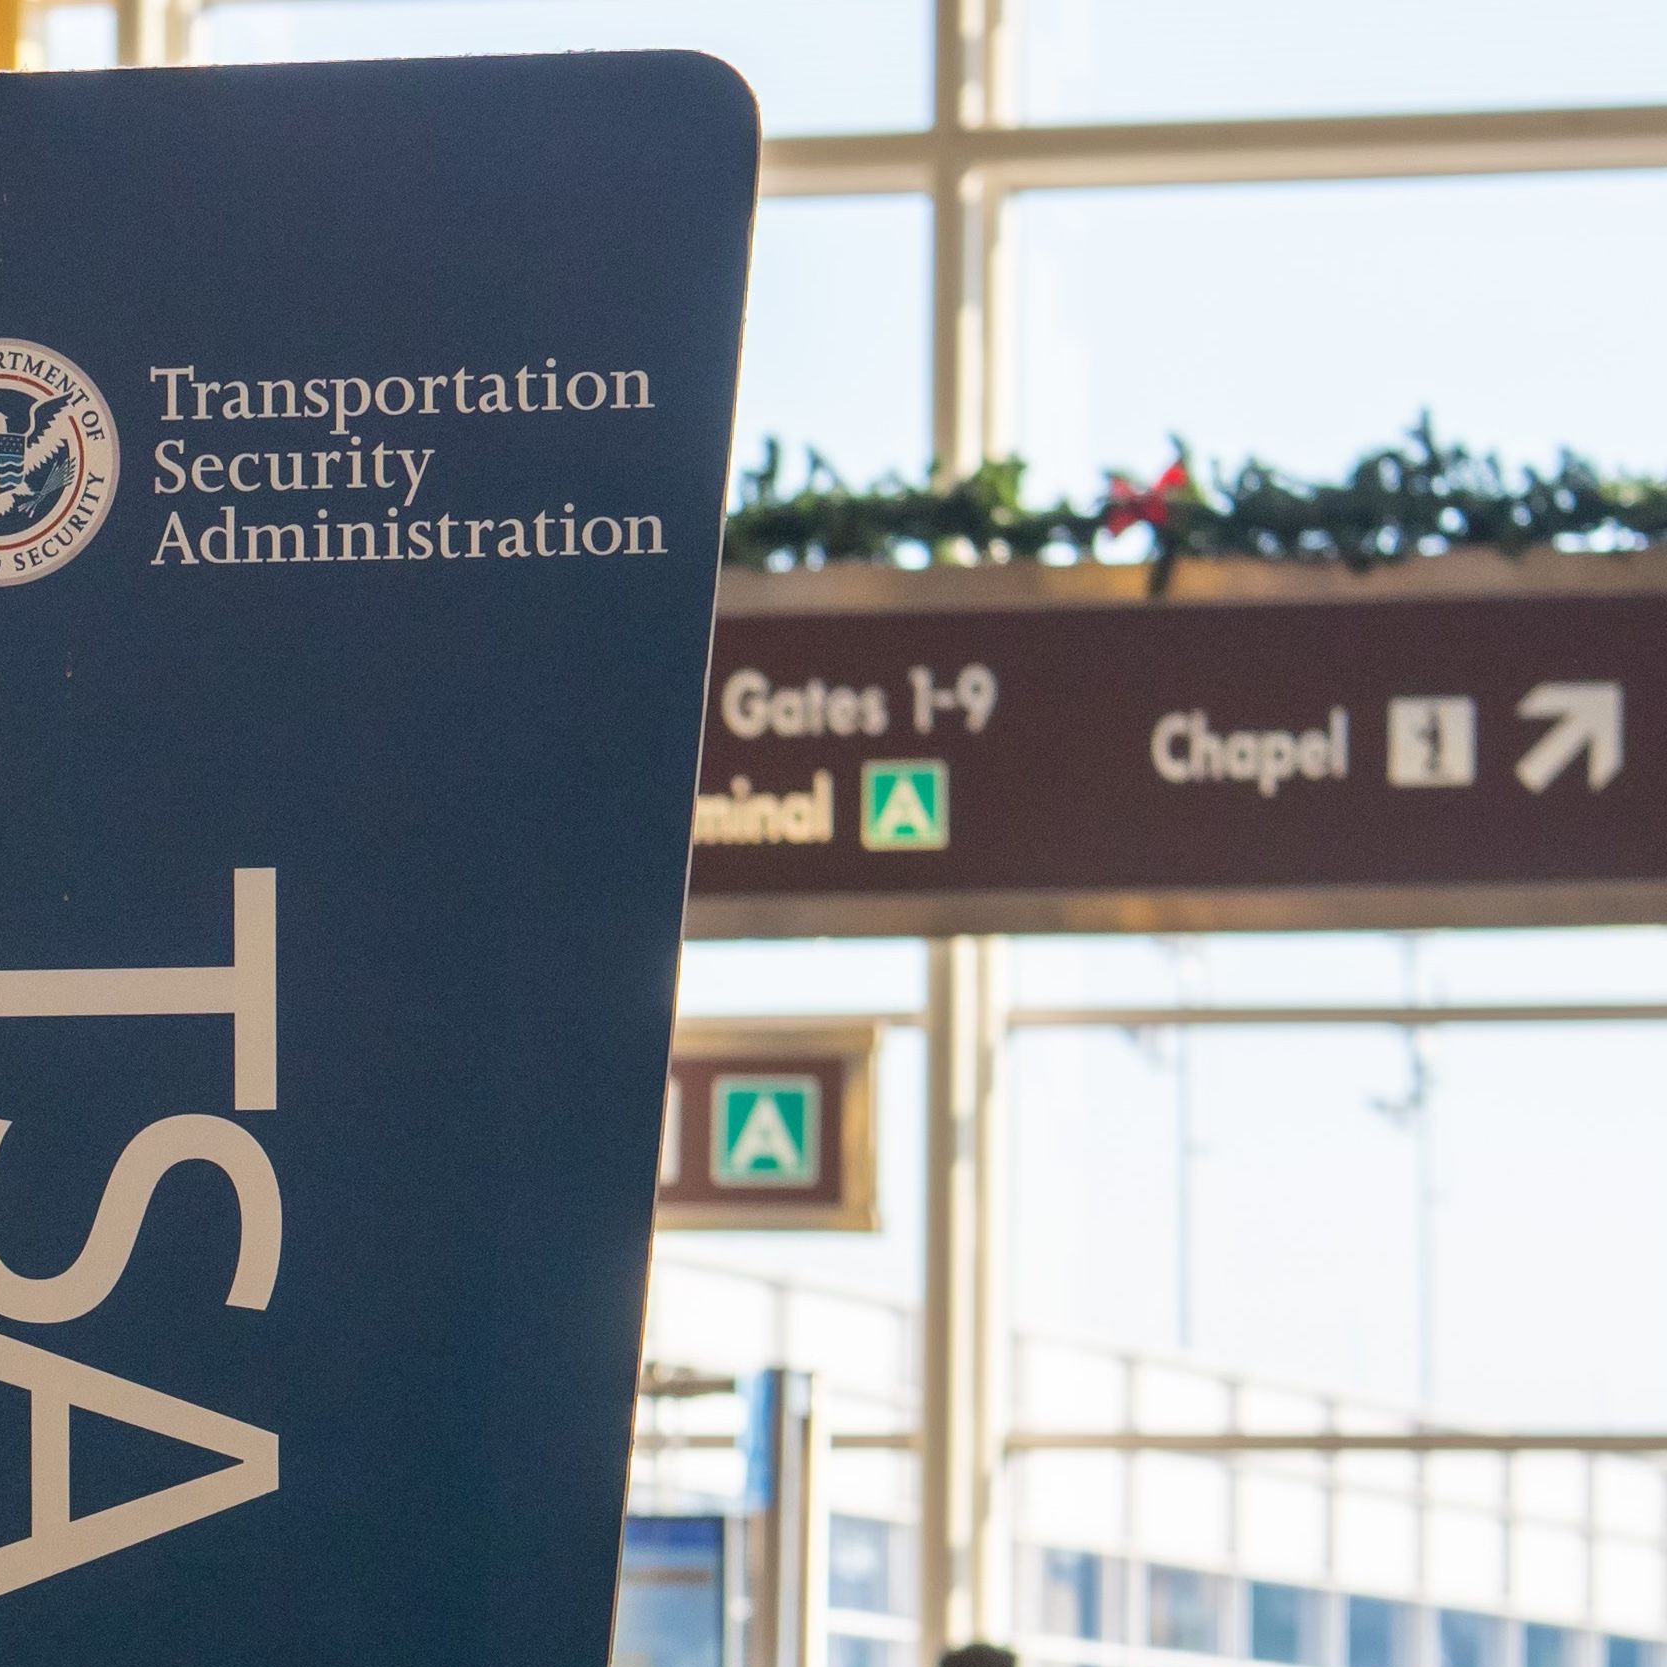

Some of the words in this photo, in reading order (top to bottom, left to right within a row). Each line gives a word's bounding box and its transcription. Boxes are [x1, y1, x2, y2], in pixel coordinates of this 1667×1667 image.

[81, 410, 105, 442] OF
[150, 358, 655, 433] Transportation
[154, 437, 435, 506] Security
[13, 472, 105, 572] SECURITY
[151, 503, 668, 565] Administration
[722, 668, 888, 740] Gates
[908, 663, 997, 735] 1-9
[1150, 706, 1349, 798] Chapel
[695, 768, 834, 846] minal
